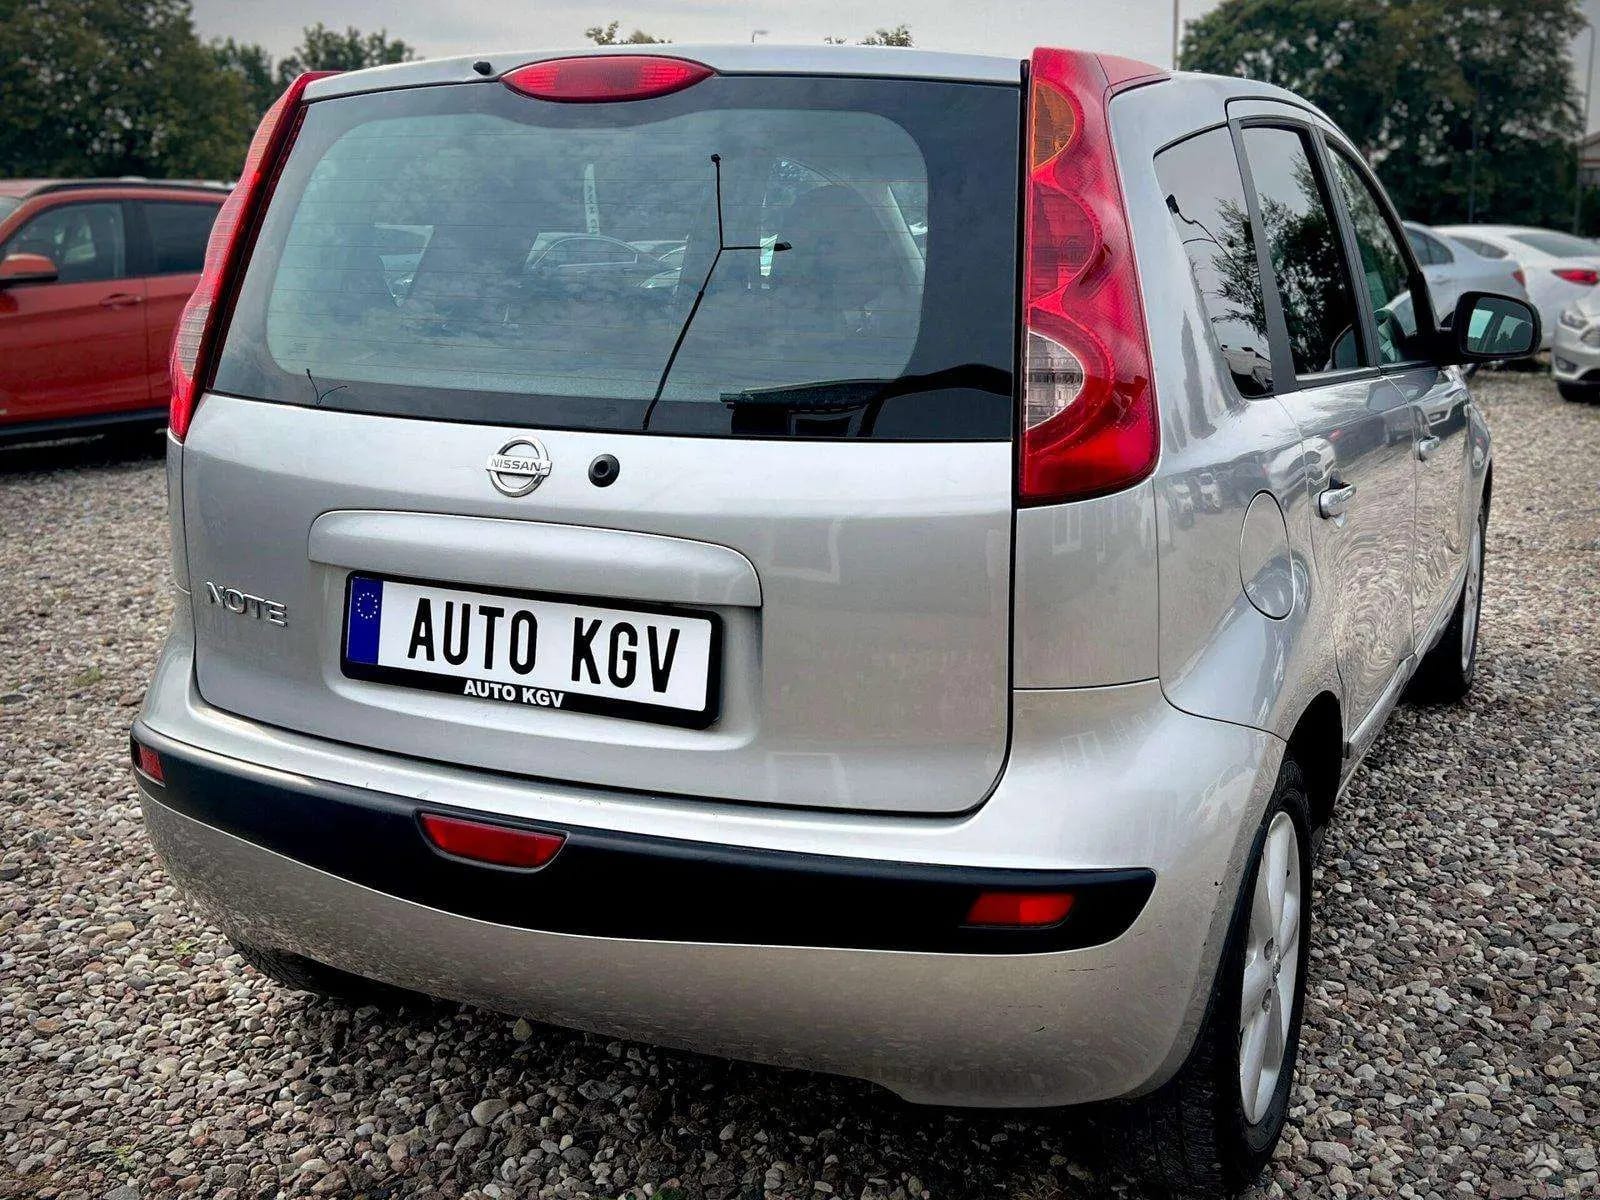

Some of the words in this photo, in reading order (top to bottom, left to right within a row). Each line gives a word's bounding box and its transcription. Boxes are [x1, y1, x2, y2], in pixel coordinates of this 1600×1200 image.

[491, 459, 541, 471] NISSAN
[206, 581, 287, 627] NOTE
[407, 597, 538, 675] AUTO
[571, 616, 681, 693] KGV
[463, 680, 516, 701] AUTO
[522, 688, 565, 708] KGV
